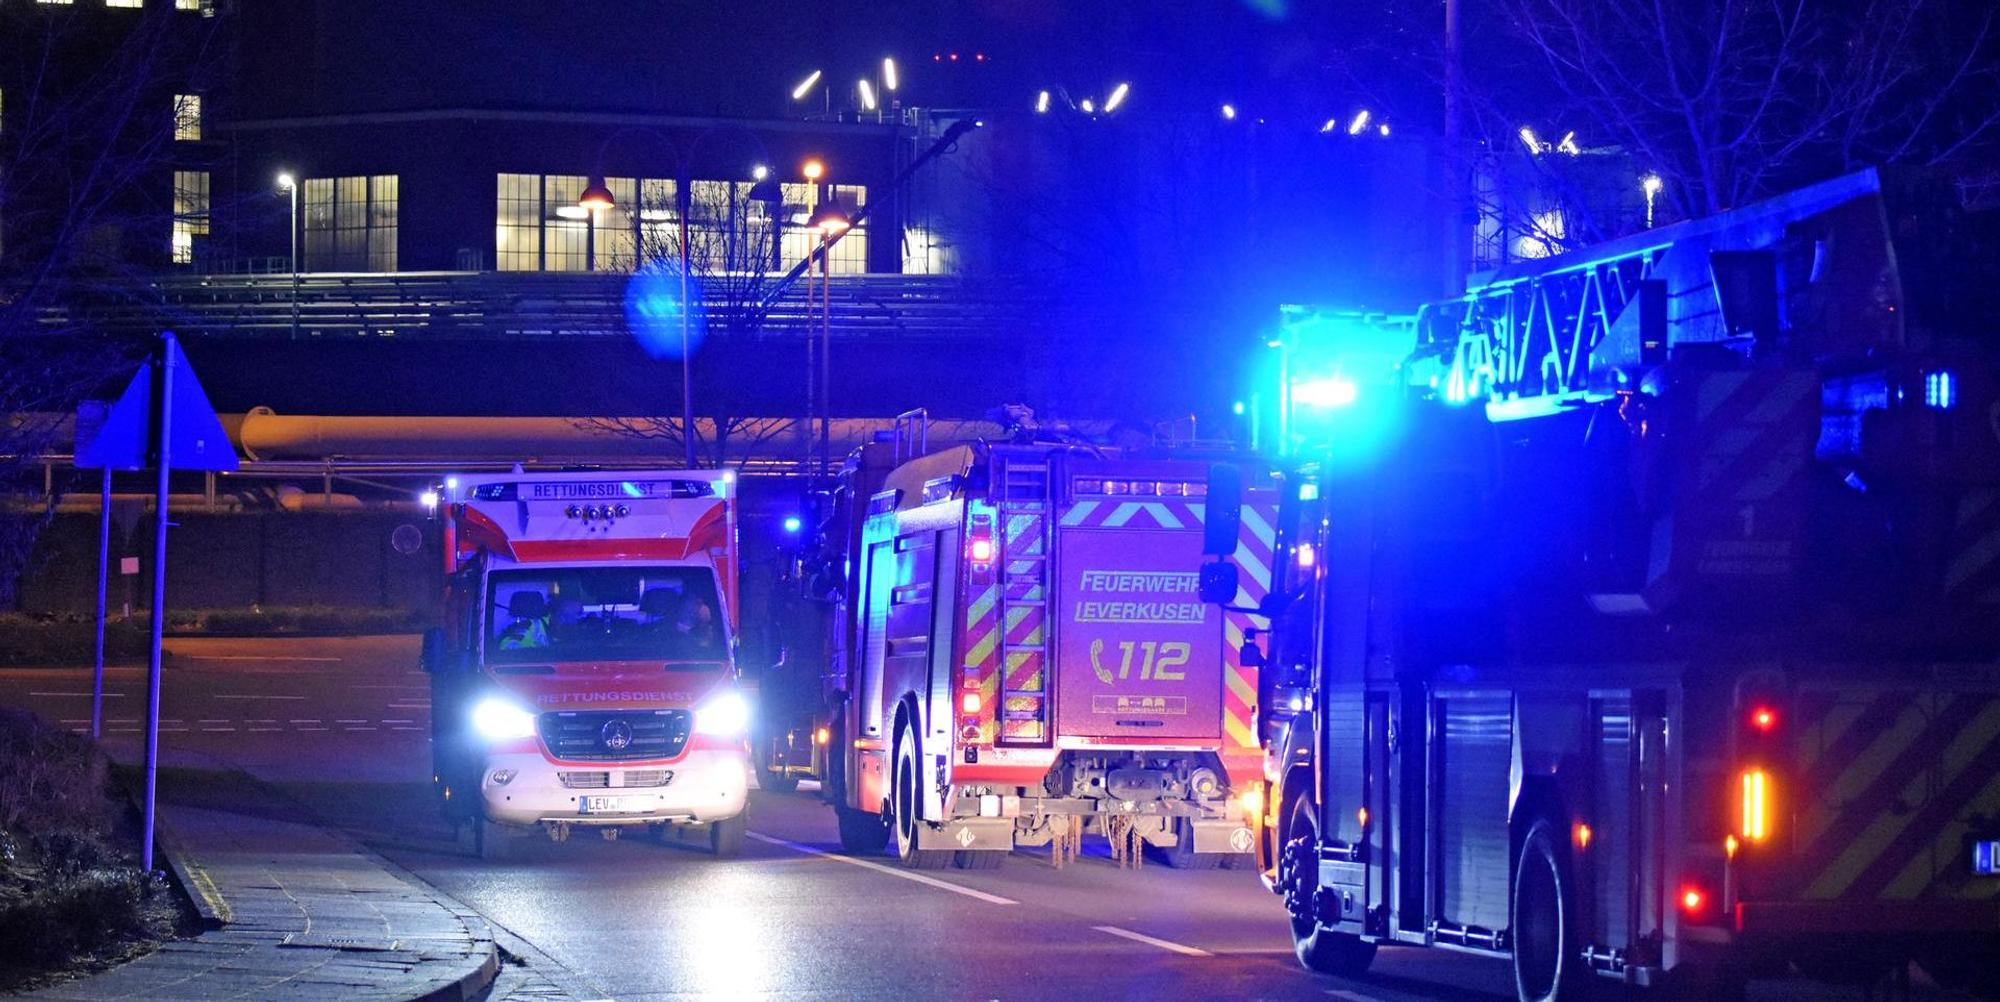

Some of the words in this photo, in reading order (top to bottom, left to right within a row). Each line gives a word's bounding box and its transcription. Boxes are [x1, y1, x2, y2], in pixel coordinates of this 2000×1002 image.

[534, 483, 655, 497] RETTUNGSDIEST
[1074, 602, 1207, 623] LEVERKUSEN
[1118, 641, 1191, 680] 112
[588, 798, 609, 810] LEV
